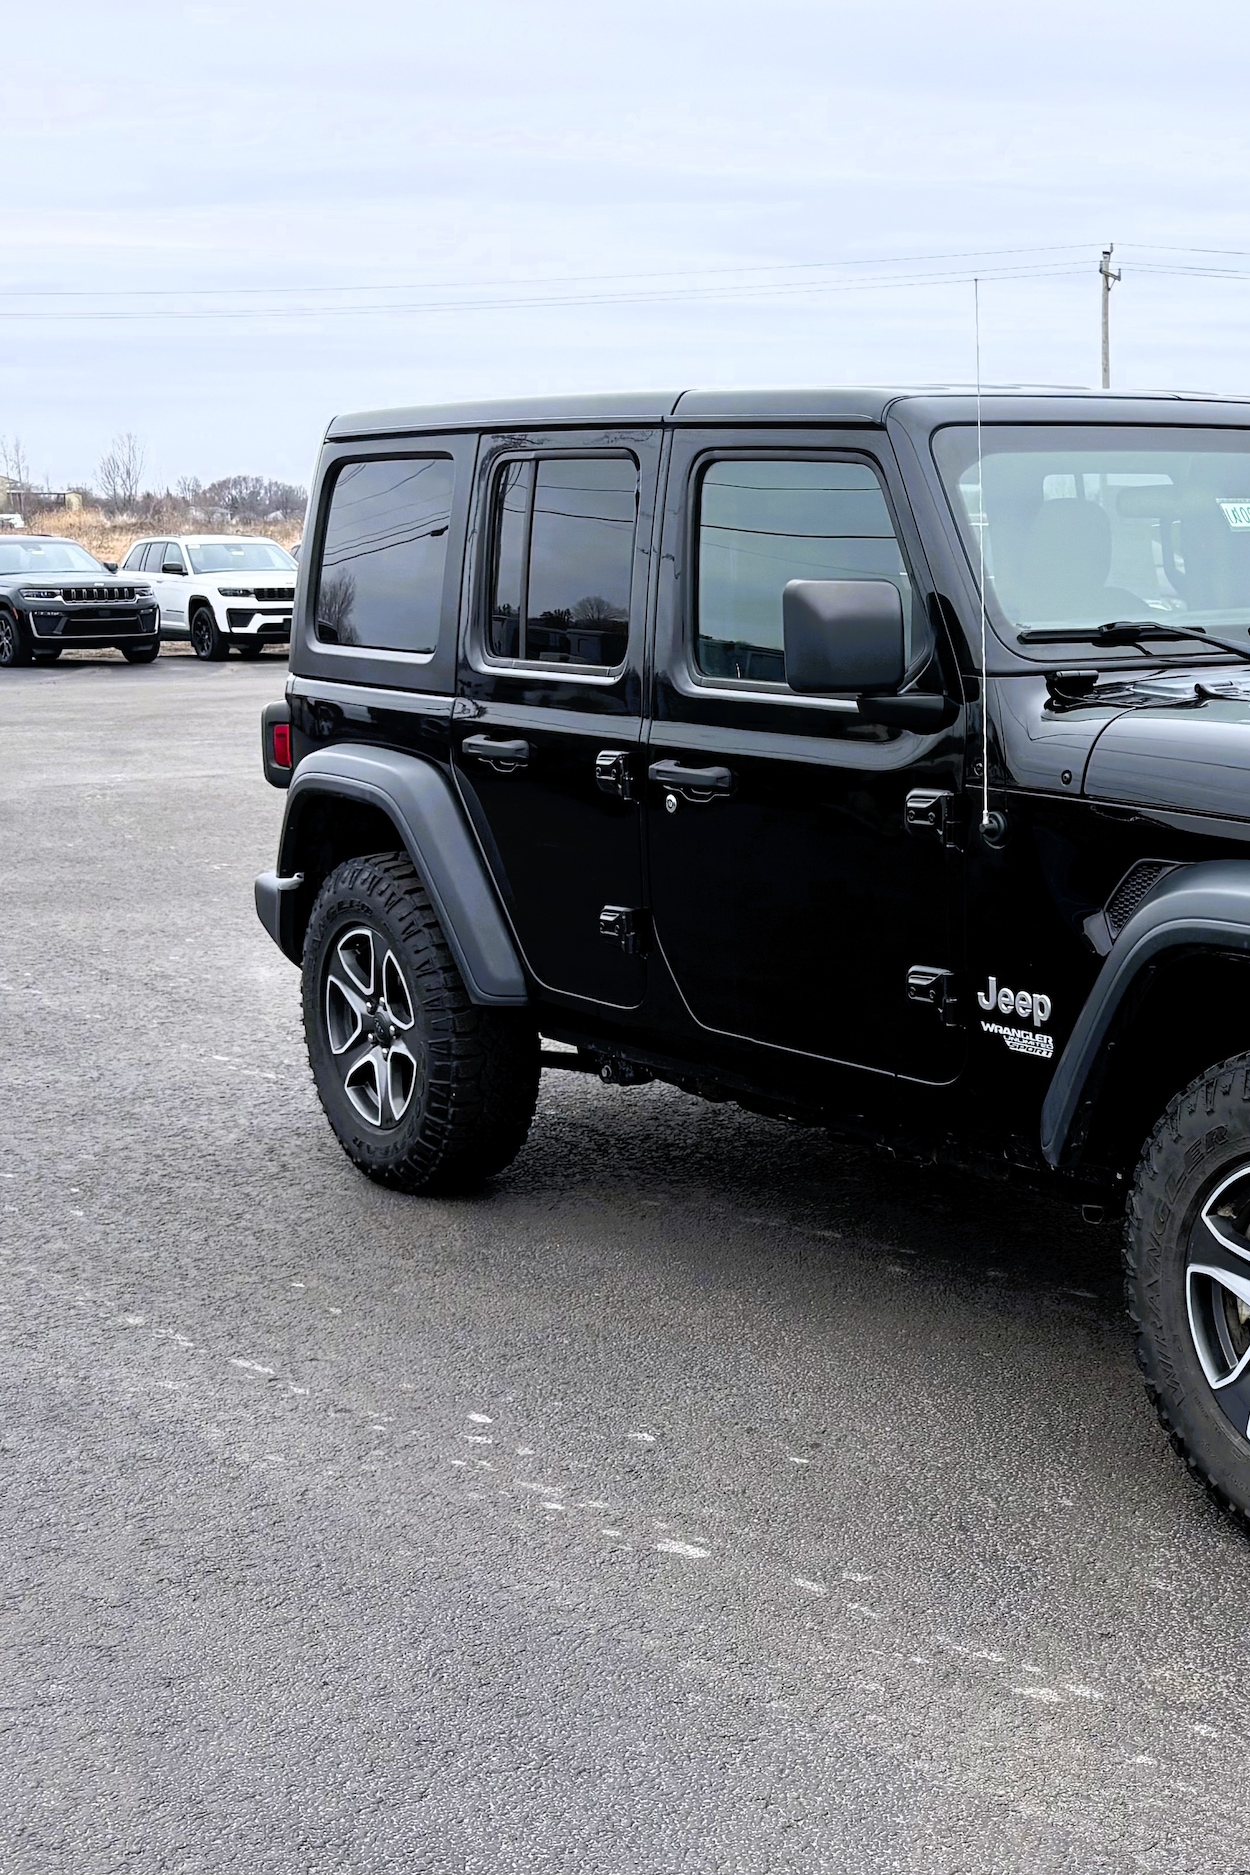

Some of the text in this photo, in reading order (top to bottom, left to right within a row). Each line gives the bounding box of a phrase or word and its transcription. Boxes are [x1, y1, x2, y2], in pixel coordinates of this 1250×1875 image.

[977, 975, 1052, 1027] Jeep
[980, 1020, 1054, 1046] WRANGLER
[1003, 1034, 1054, 1050] UNLIMITED
[1005, 1042, 1053, 1058] SPORT
[1144, 1124, 1230, 1408] WRANGLER
